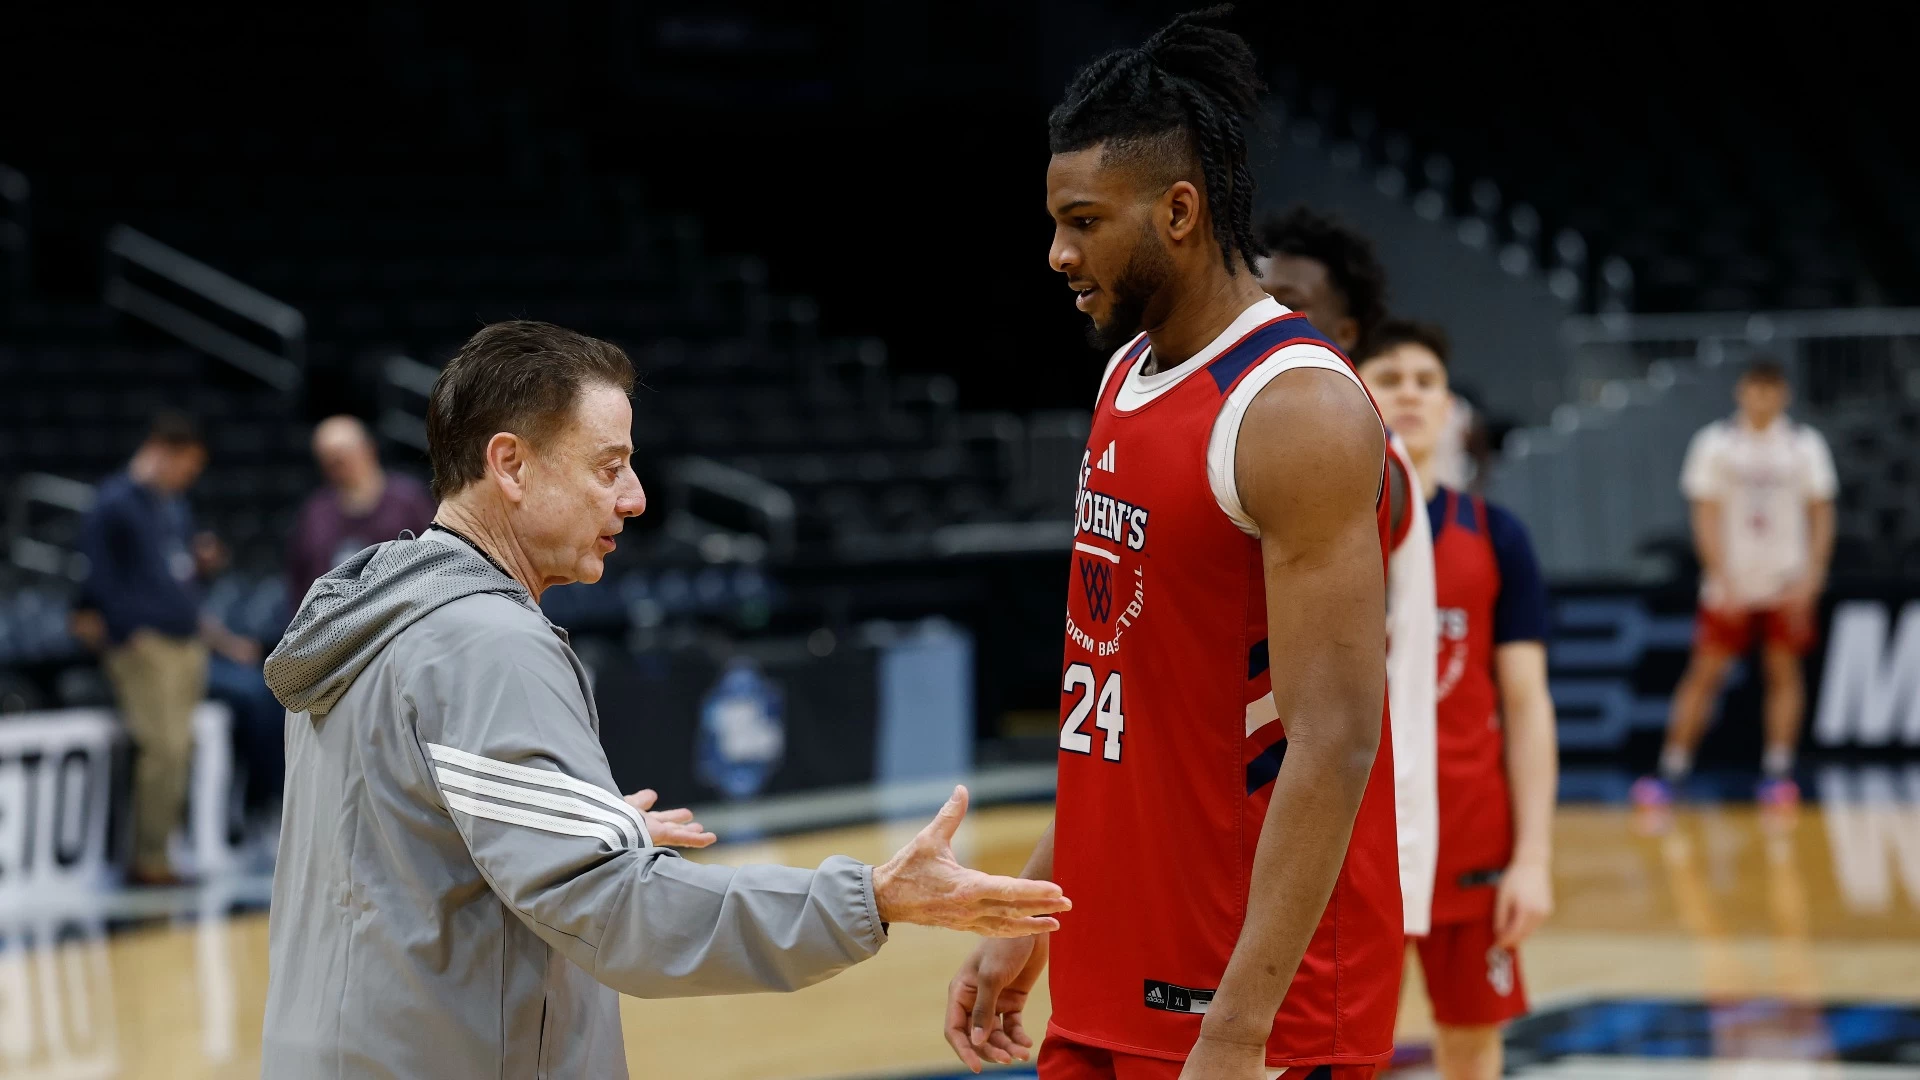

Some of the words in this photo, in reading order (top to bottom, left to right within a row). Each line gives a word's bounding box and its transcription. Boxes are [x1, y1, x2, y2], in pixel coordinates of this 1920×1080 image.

[1074, 490, 1148, 550] JOHN'S
[1098, 564, 1144, 656] BASETBALL
[1060, 662, 1124, 762] 24
[0, 747, 92, 872] TO
[1145, 996, 1165, 1004] adidas
[1174, 996, 1184, 1007] XL
